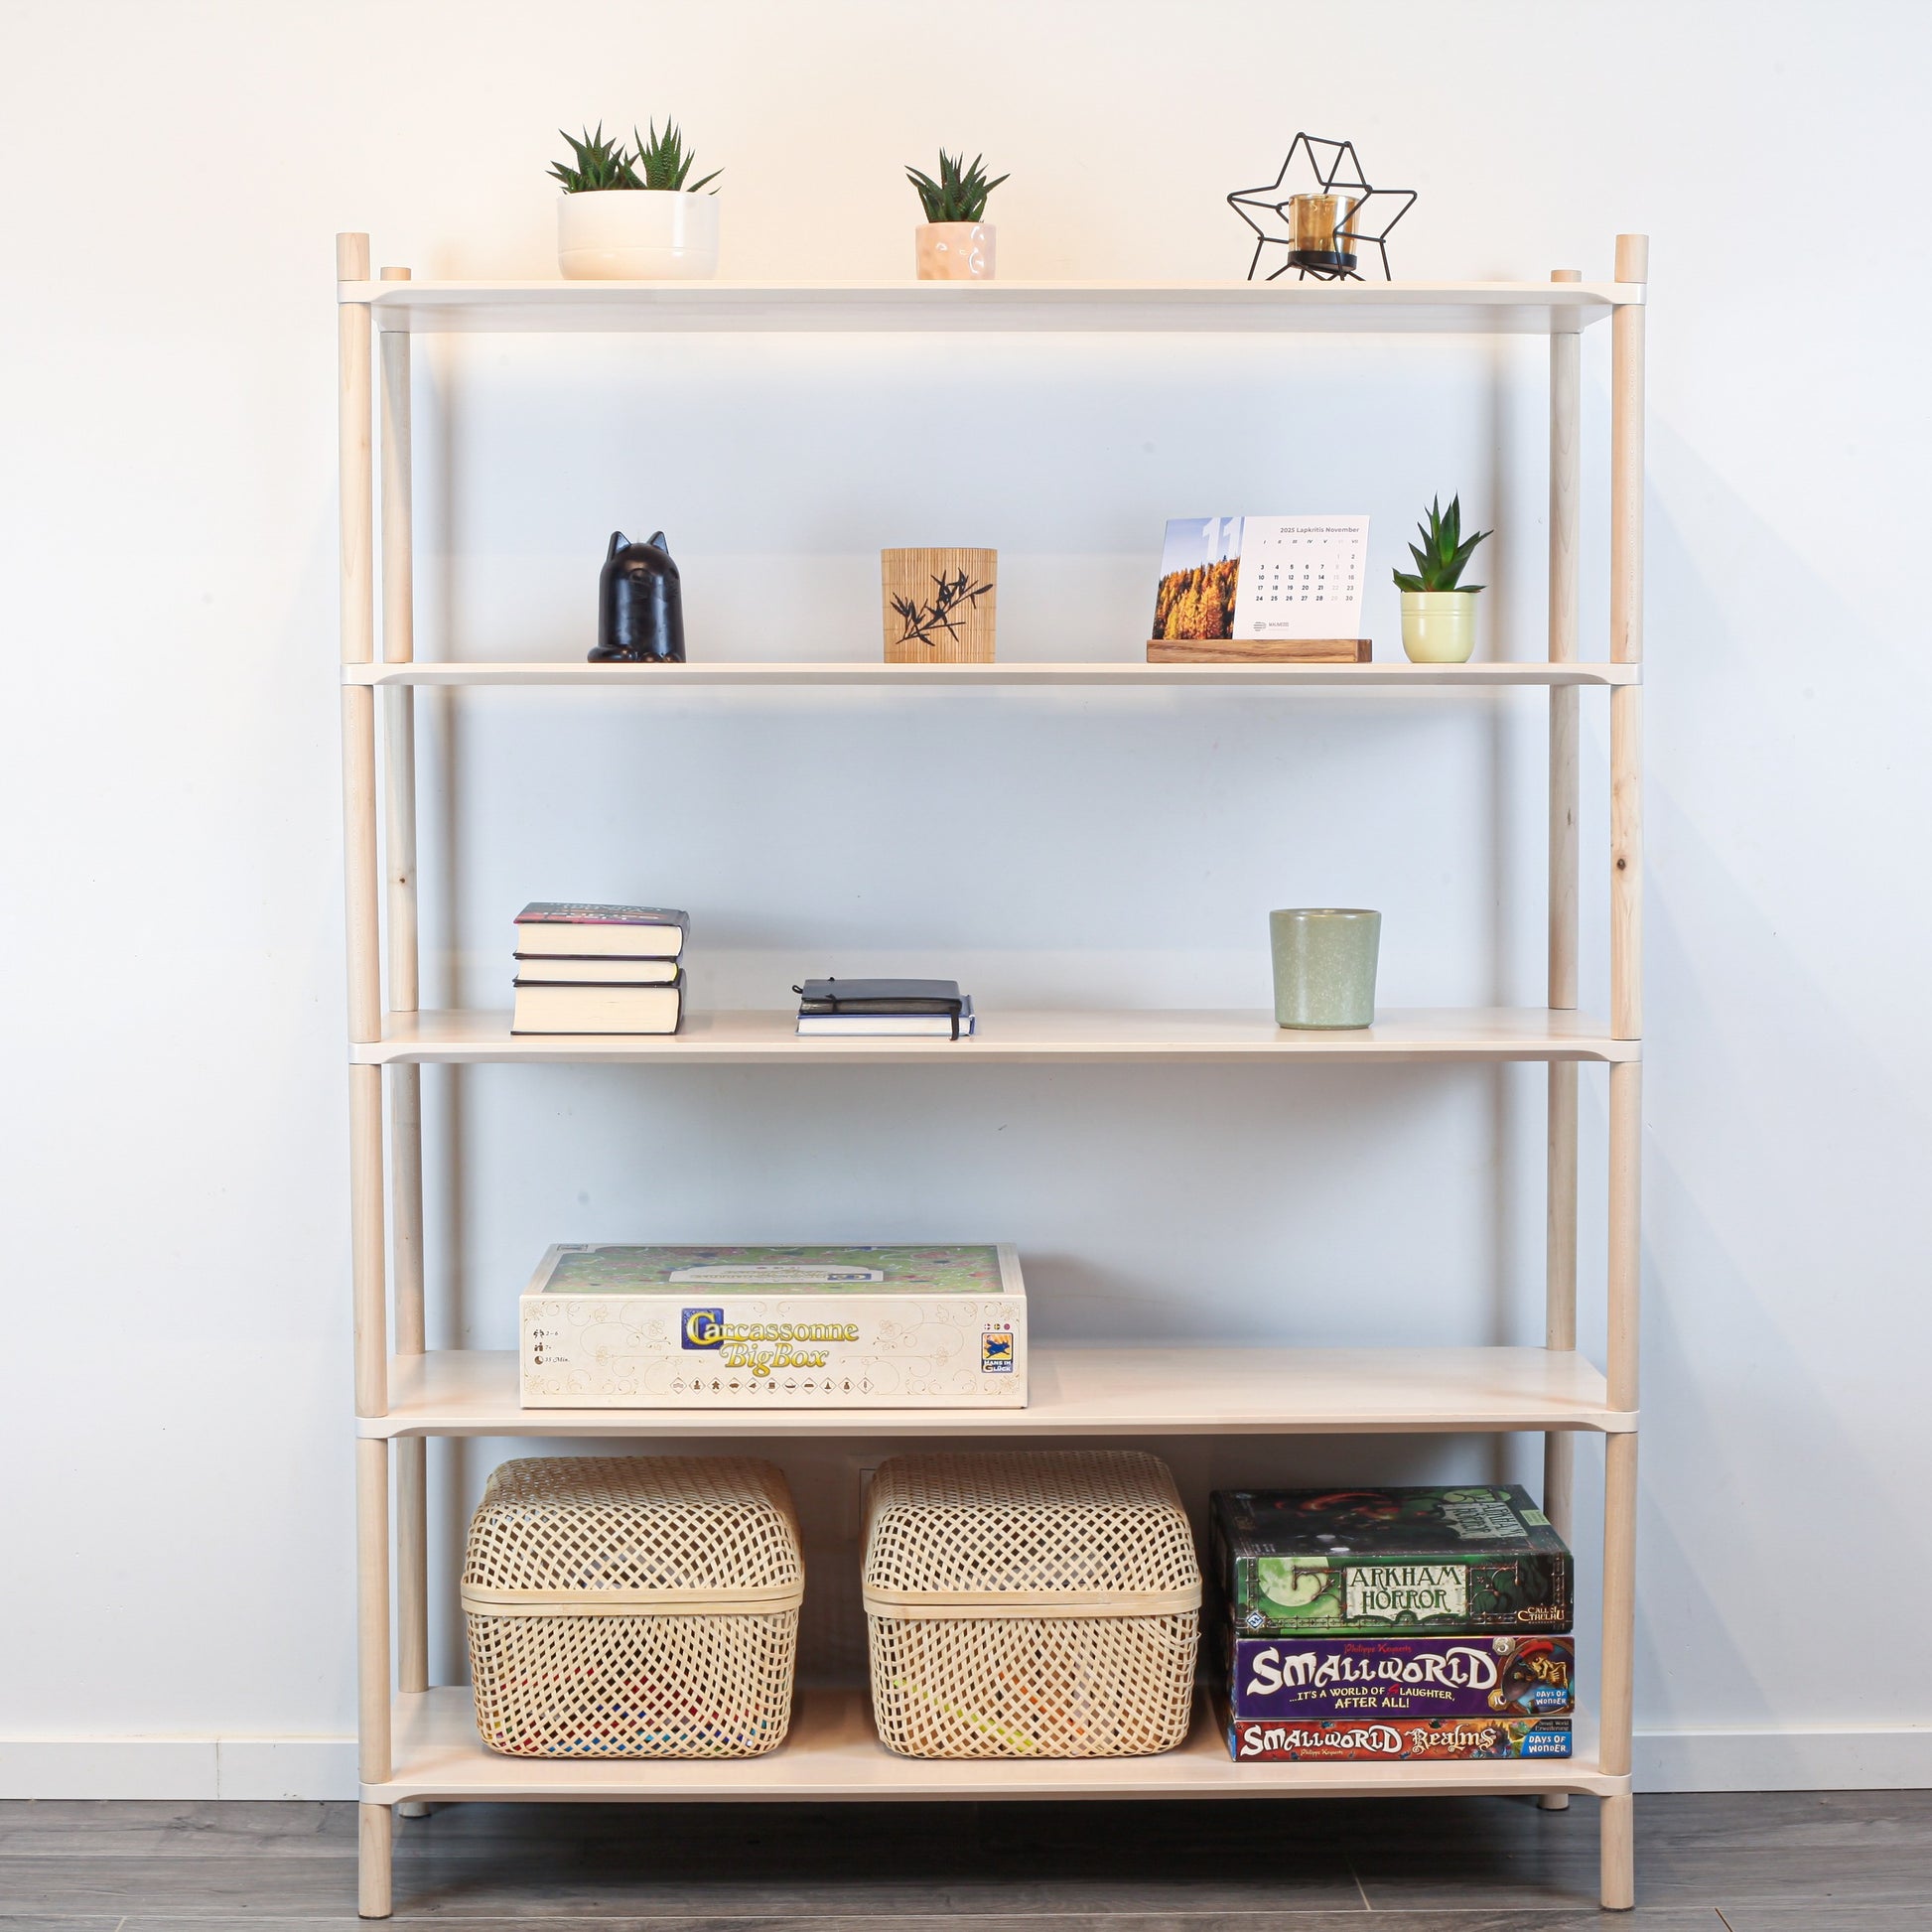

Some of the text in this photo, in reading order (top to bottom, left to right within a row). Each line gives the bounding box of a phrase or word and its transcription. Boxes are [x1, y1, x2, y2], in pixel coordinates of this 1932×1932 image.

[686, 1311, 860, 1346] Carcassonne
[1349, 1566, 1461, 1590] ARKHAM
[1362, 1589, 1451, 1614] HORROR
[1517, 1609, 1565, 1621] CTHULHU
[1344, 1643, 1376, 1655] Philippe
[1319, 1689, 1327, 1698] A
[1329, 1686, 1368, 1697] WORLD
[1370, 1686, 1386, 1695] OF
[1334, 1697, 1410, 1709] AFTER ALL!
[1405, 1724, 1497, 1755] Realms
[1528, 1734, 1567, 1744] DAYS OF
[1528, 1744, 1567, 1753] WONDER
